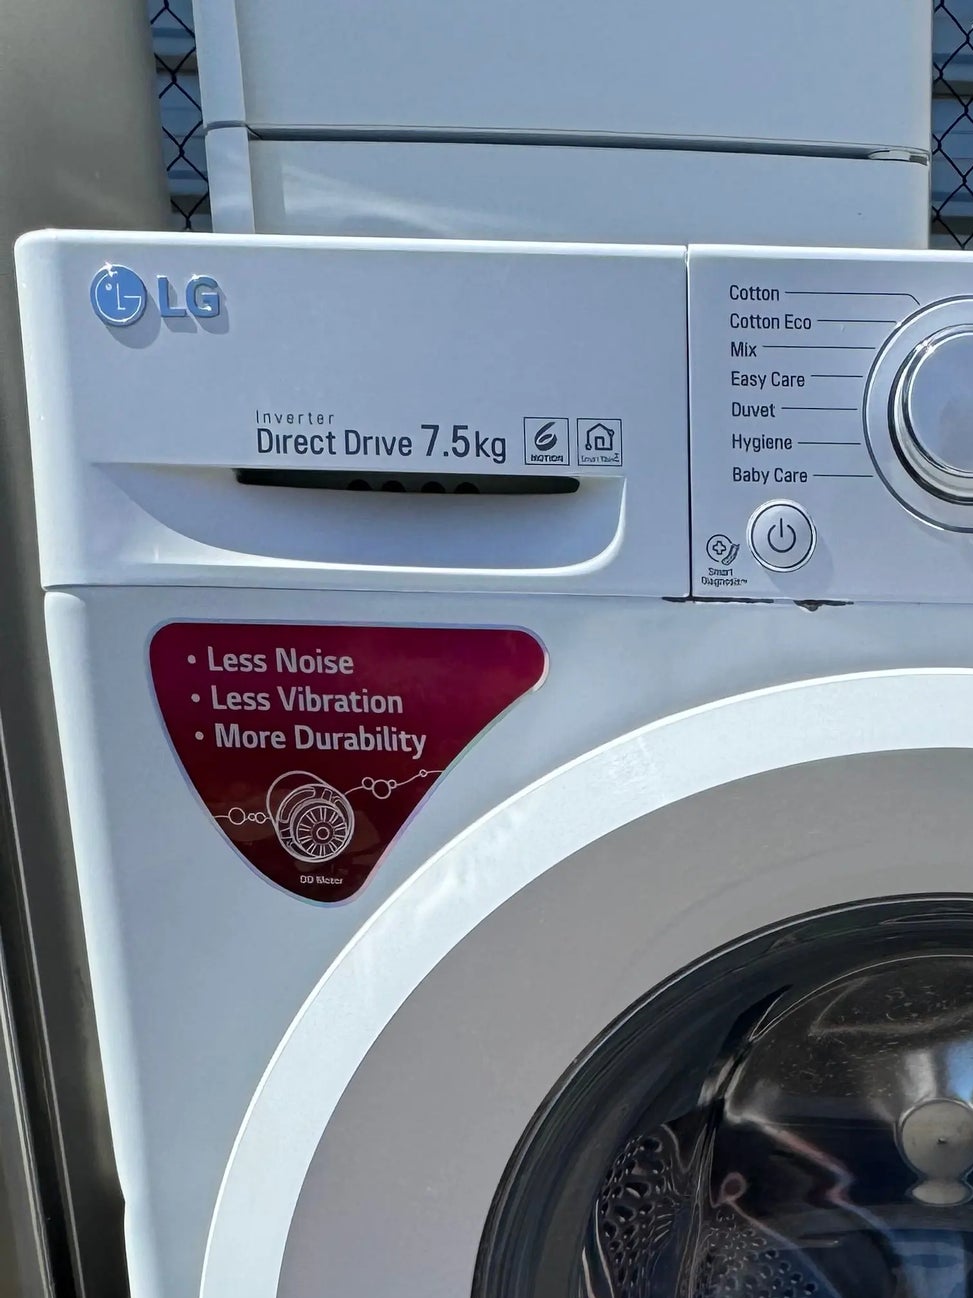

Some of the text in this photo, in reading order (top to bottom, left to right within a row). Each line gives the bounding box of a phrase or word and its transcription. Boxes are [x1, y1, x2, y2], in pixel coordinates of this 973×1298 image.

[157, 274, 221, 318] LG
[729, 285, 780, 302] Cotton
[730, 314, 812, 331] Cotton Eco
[730, 342, 757, 357] Mix
[731, 371, 805, 390] Easy Care
[255, 410, 334, 425] Inverter
[731, 402, 776, 419] Duvet
[257, 427, 336, 456] Direct
[345, 430, 413, 457] Drive
[731, 434, 793, 452] Hygiene
[732, 467, 808, 486] Baby Care
[708, 567, 733, 576] Smart
[207, 646, 354, 675] Less Noise
[211, 685, 403, 714] Less Vibration
[215, 723, 427, 760] More Durability
